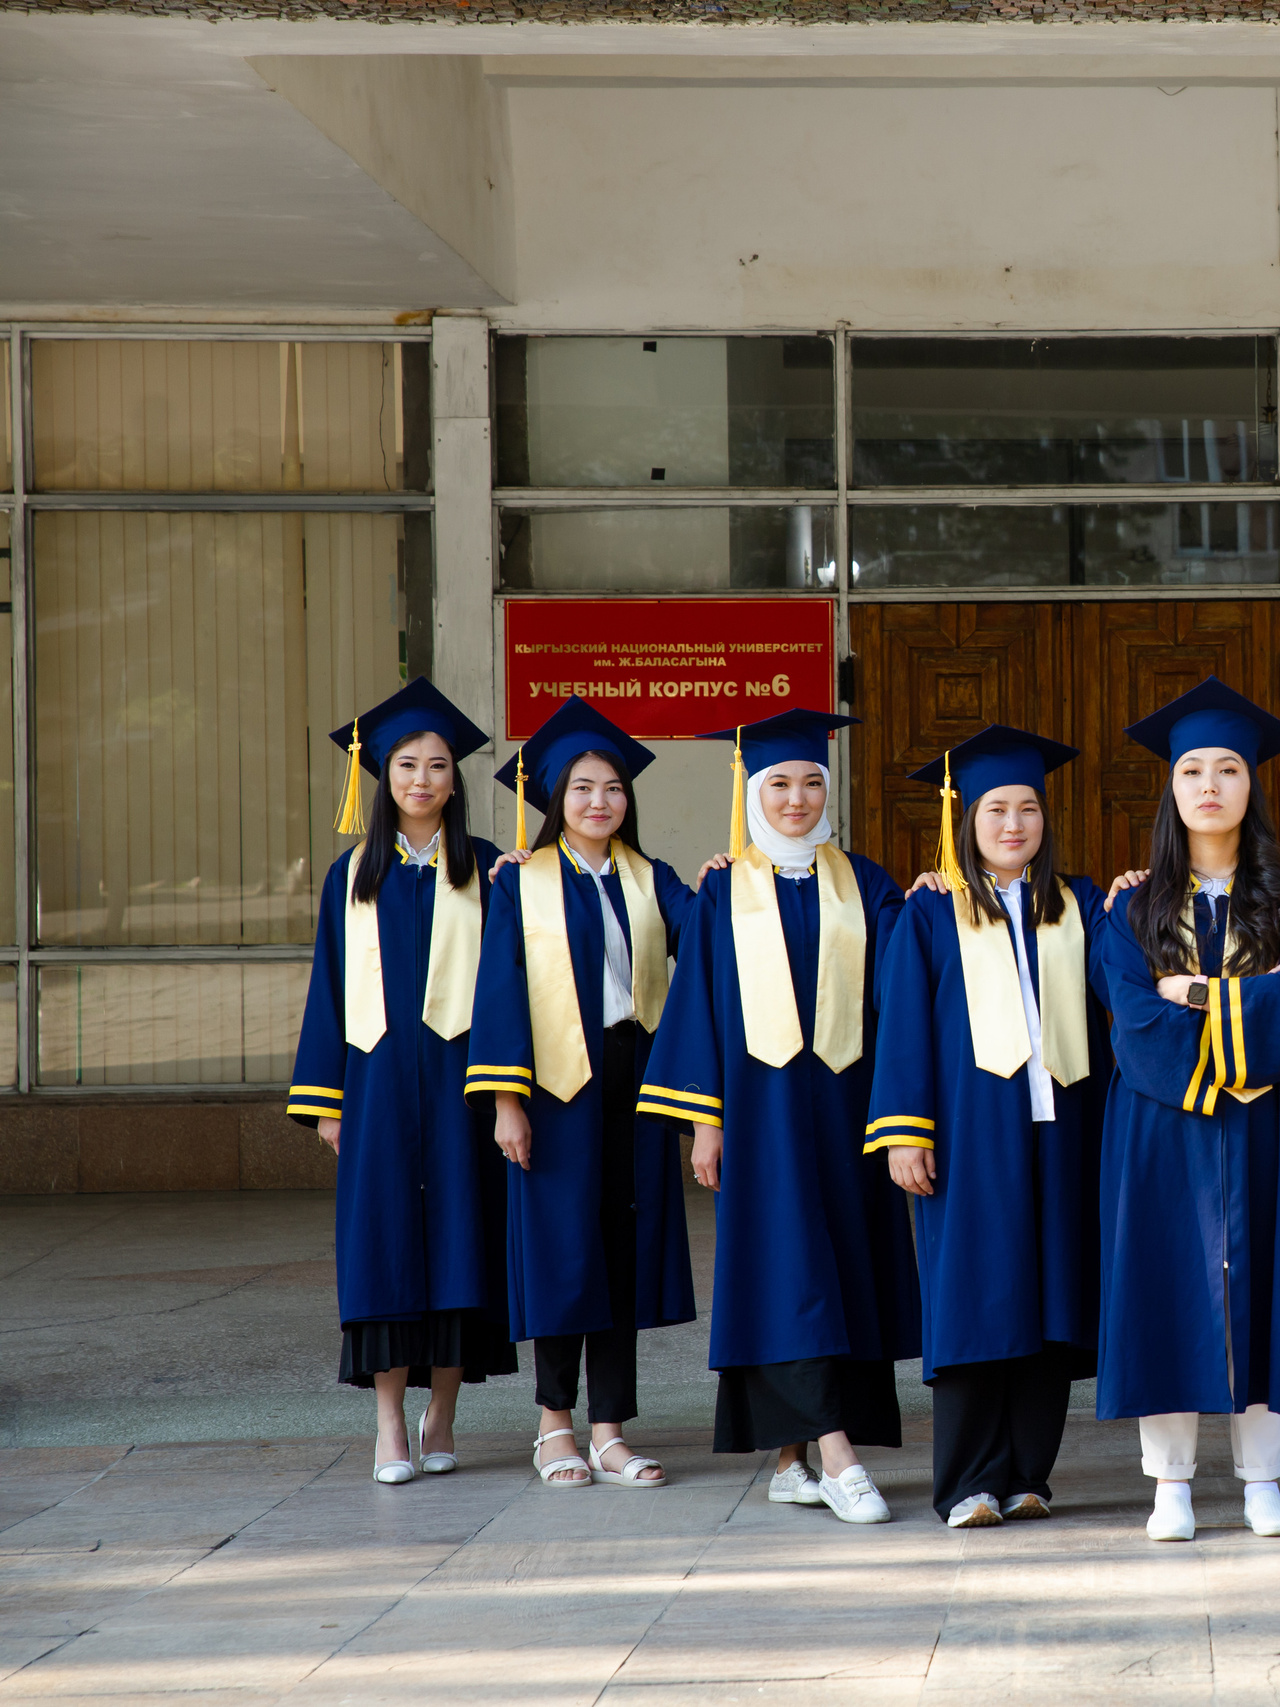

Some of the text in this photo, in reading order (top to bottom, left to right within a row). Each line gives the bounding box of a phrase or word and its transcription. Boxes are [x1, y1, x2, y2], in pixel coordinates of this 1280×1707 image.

[515, 642, 823, 655] КЫРГЫЗСКИЙ НАЦИОНАЛЬНЫЙ УНИВЕРСИТЕТ
[593, 657, 727, 667] им. Ж.БАЛАСАГЫНА
[529, 674, 791, 697] УЧЕБНЫЙ КОРПУС №6
